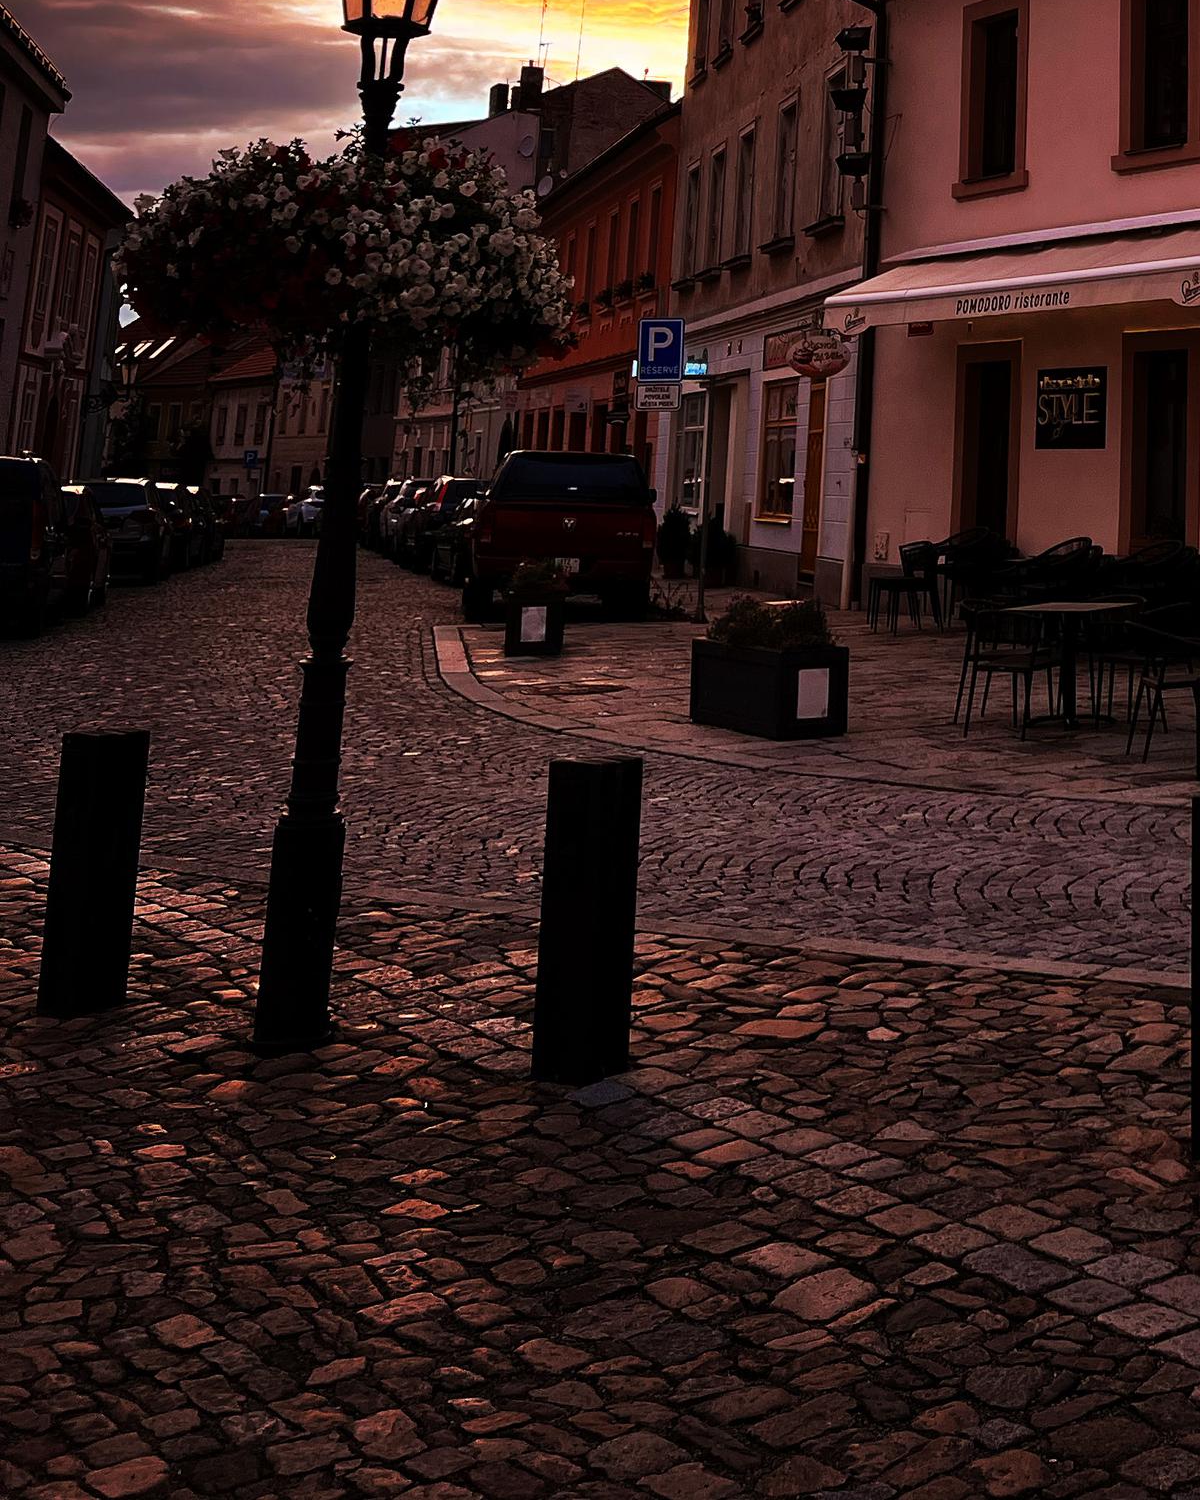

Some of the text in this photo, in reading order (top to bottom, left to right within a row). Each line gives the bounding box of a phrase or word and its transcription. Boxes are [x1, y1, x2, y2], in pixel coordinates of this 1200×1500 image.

[956, 290, 1070, 315] POMODORO ristorante
[648, 326, 674, 362] P
[1038, 393, 1101, 425] STYLE
